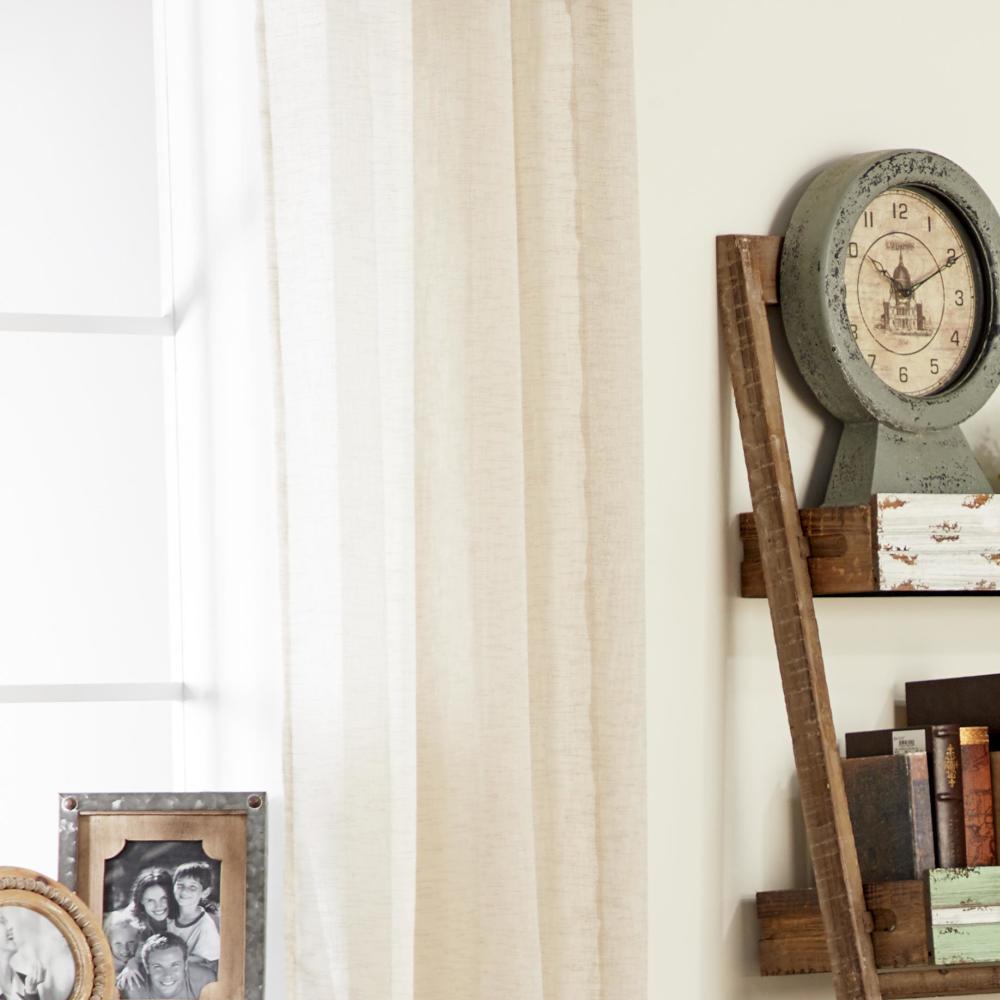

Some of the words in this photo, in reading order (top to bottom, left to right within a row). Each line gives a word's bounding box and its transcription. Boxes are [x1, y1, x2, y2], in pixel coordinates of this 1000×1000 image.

[864, 211, 873, 227] 11
[892, 202, 908, 219] 12
[927, 216, 931, 232] 1
[848, 242, 858, 258] 0
[954, 289, 964, 306] 3
[950, 330, 960, 347] 4
[867, 354, 877, 369] 7
[930, 358, 939, 375] 5
[899, 366, 908, 383] 6
